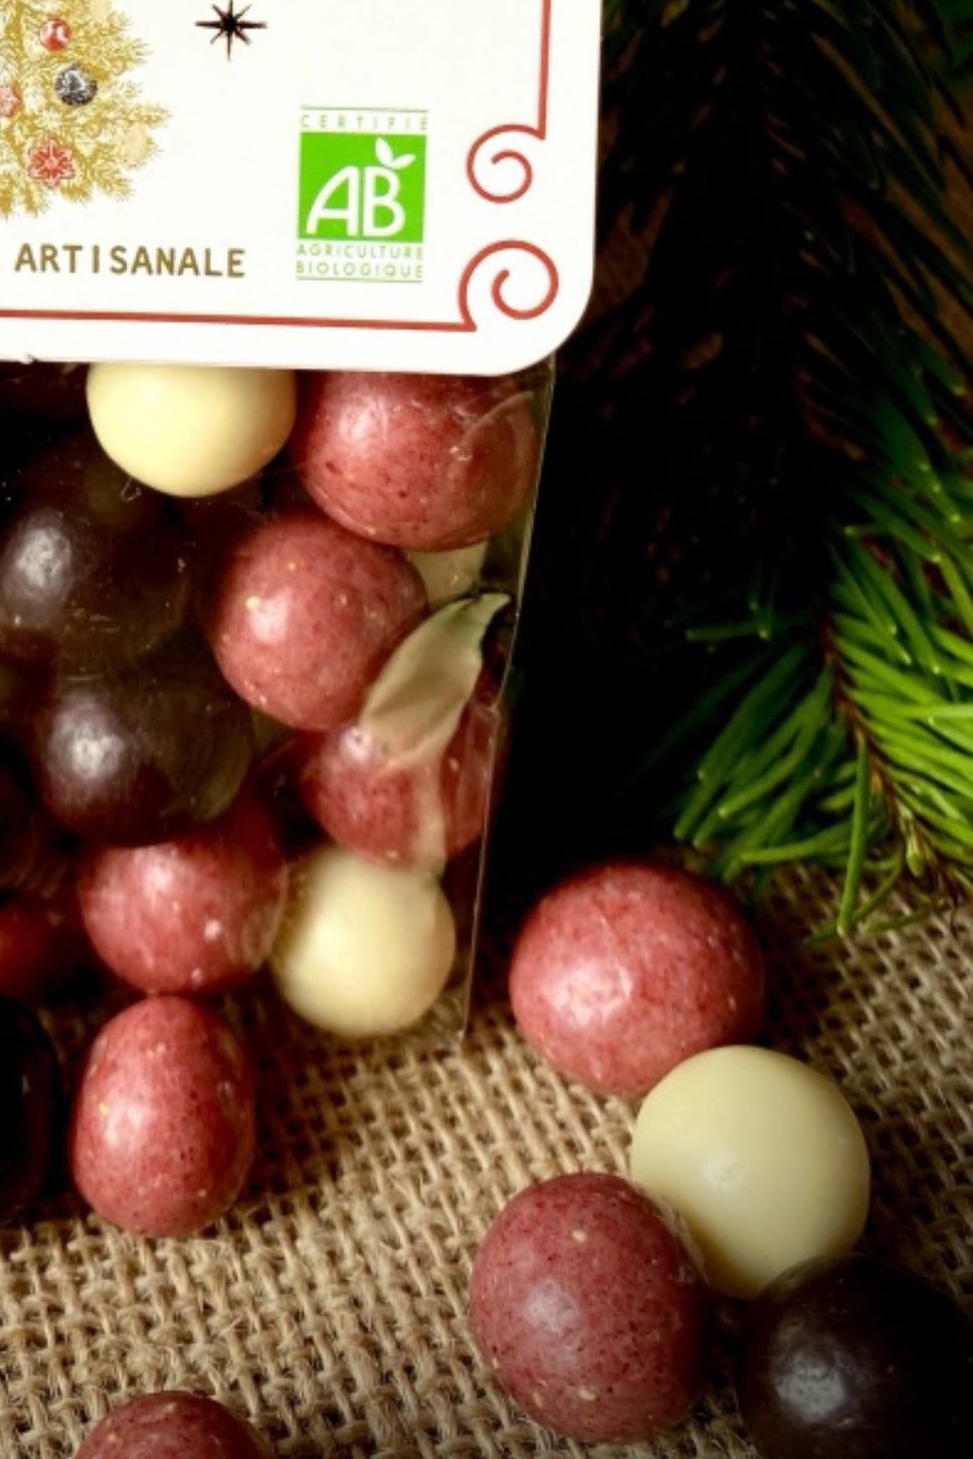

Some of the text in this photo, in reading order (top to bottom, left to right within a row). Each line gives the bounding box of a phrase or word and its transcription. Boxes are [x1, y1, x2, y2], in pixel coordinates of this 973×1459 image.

[306, 165, 406, 237] AB
[14, 243, 246, 278] ARTISANALE
[296, 244, 423, 260] AGRICULTURE
[296, 261, 423, 278] BIOLOGIQUE
